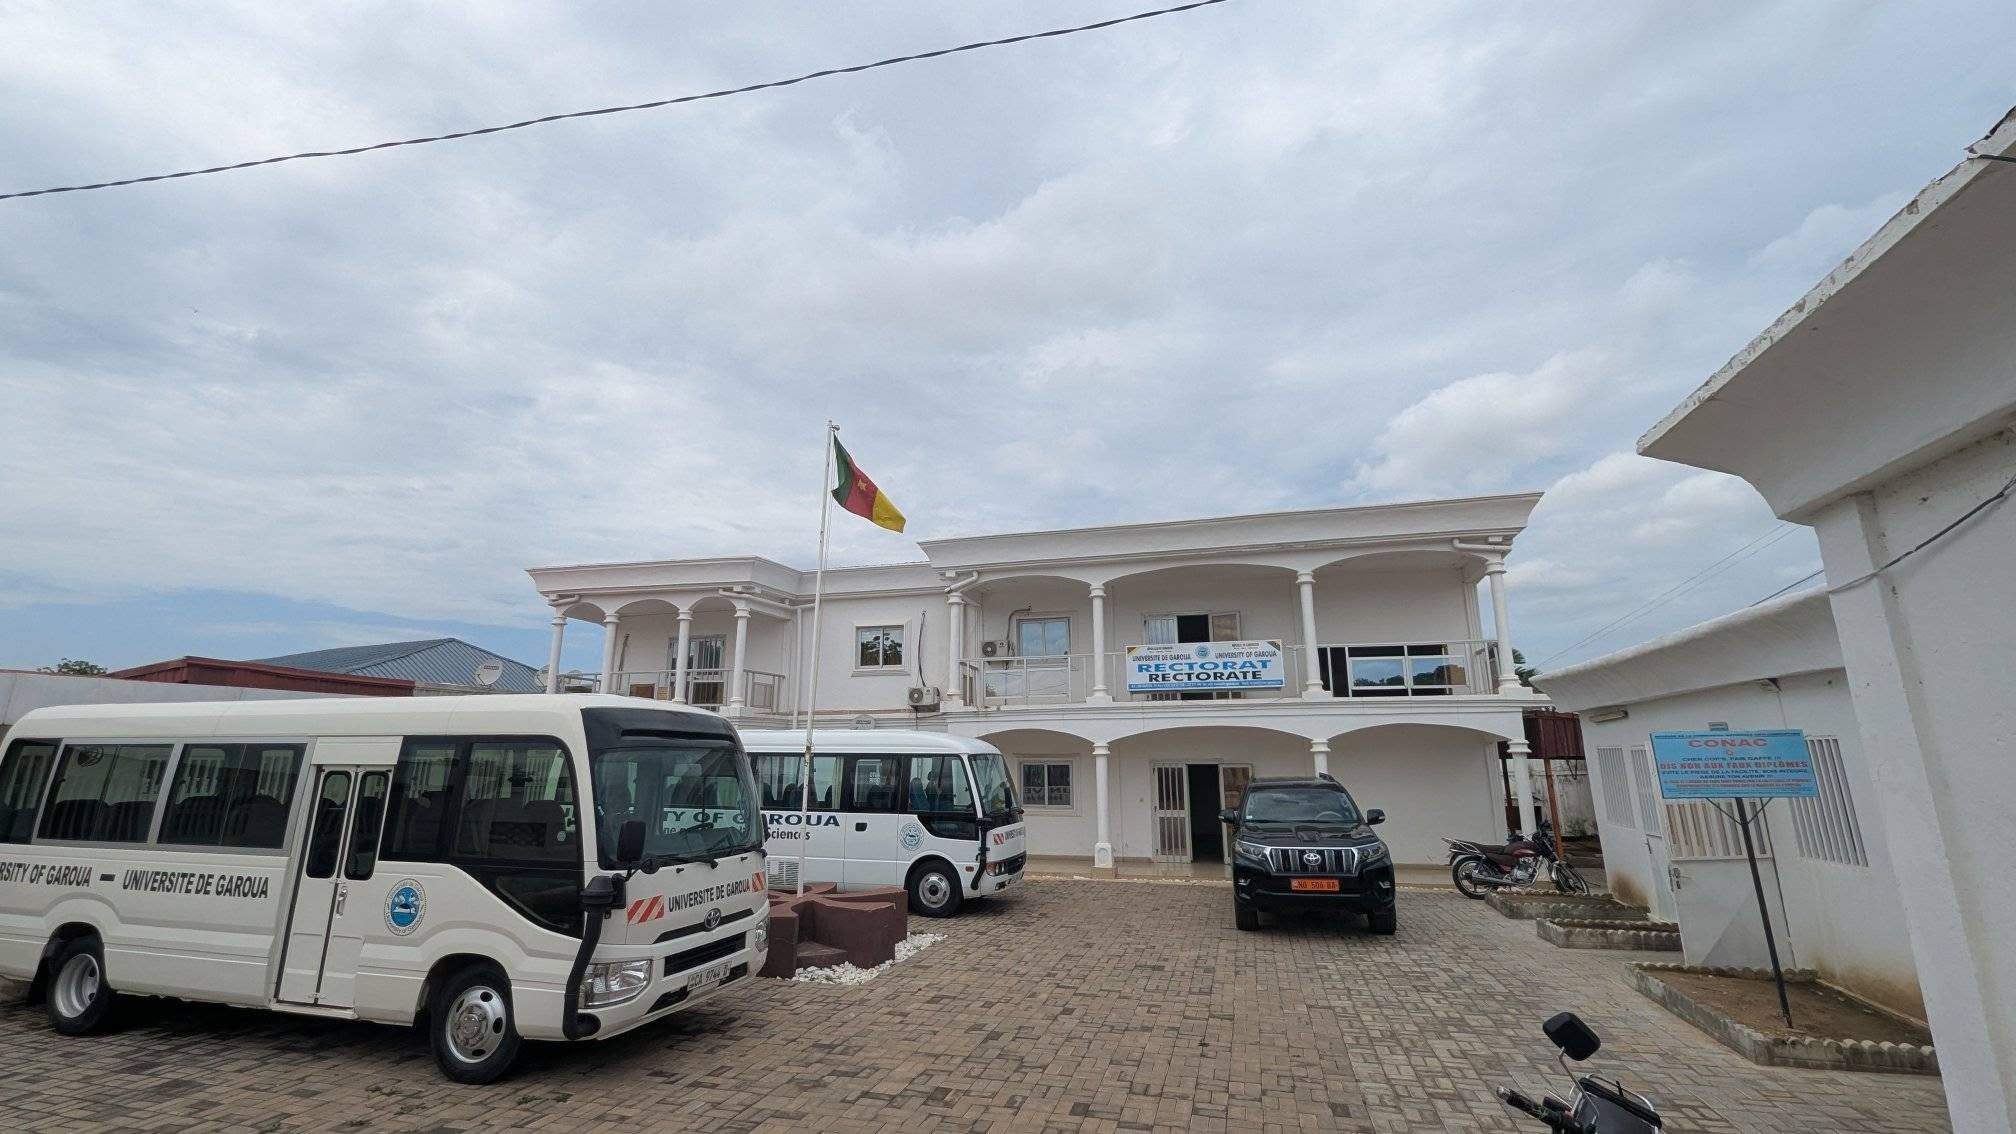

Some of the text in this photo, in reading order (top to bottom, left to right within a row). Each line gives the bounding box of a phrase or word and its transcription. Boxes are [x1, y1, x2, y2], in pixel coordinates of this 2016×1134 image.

[1137, 660, 1271, 672] RECTORAT
[1149, 671, 1262, 682] RECTORATE
[1689, 739, 1767, 747] CONAC
[30, 864, 46, 884] OF
[46, 865, 92, 887] GAROUA
[122, 869, 196, 893] UNIVERSITE
[195, 873, 214, 895] DE
[215, 874, 269, 898] GAROUA
[668, 878, 751, 912] UNIVERSITE DE GAROUA
